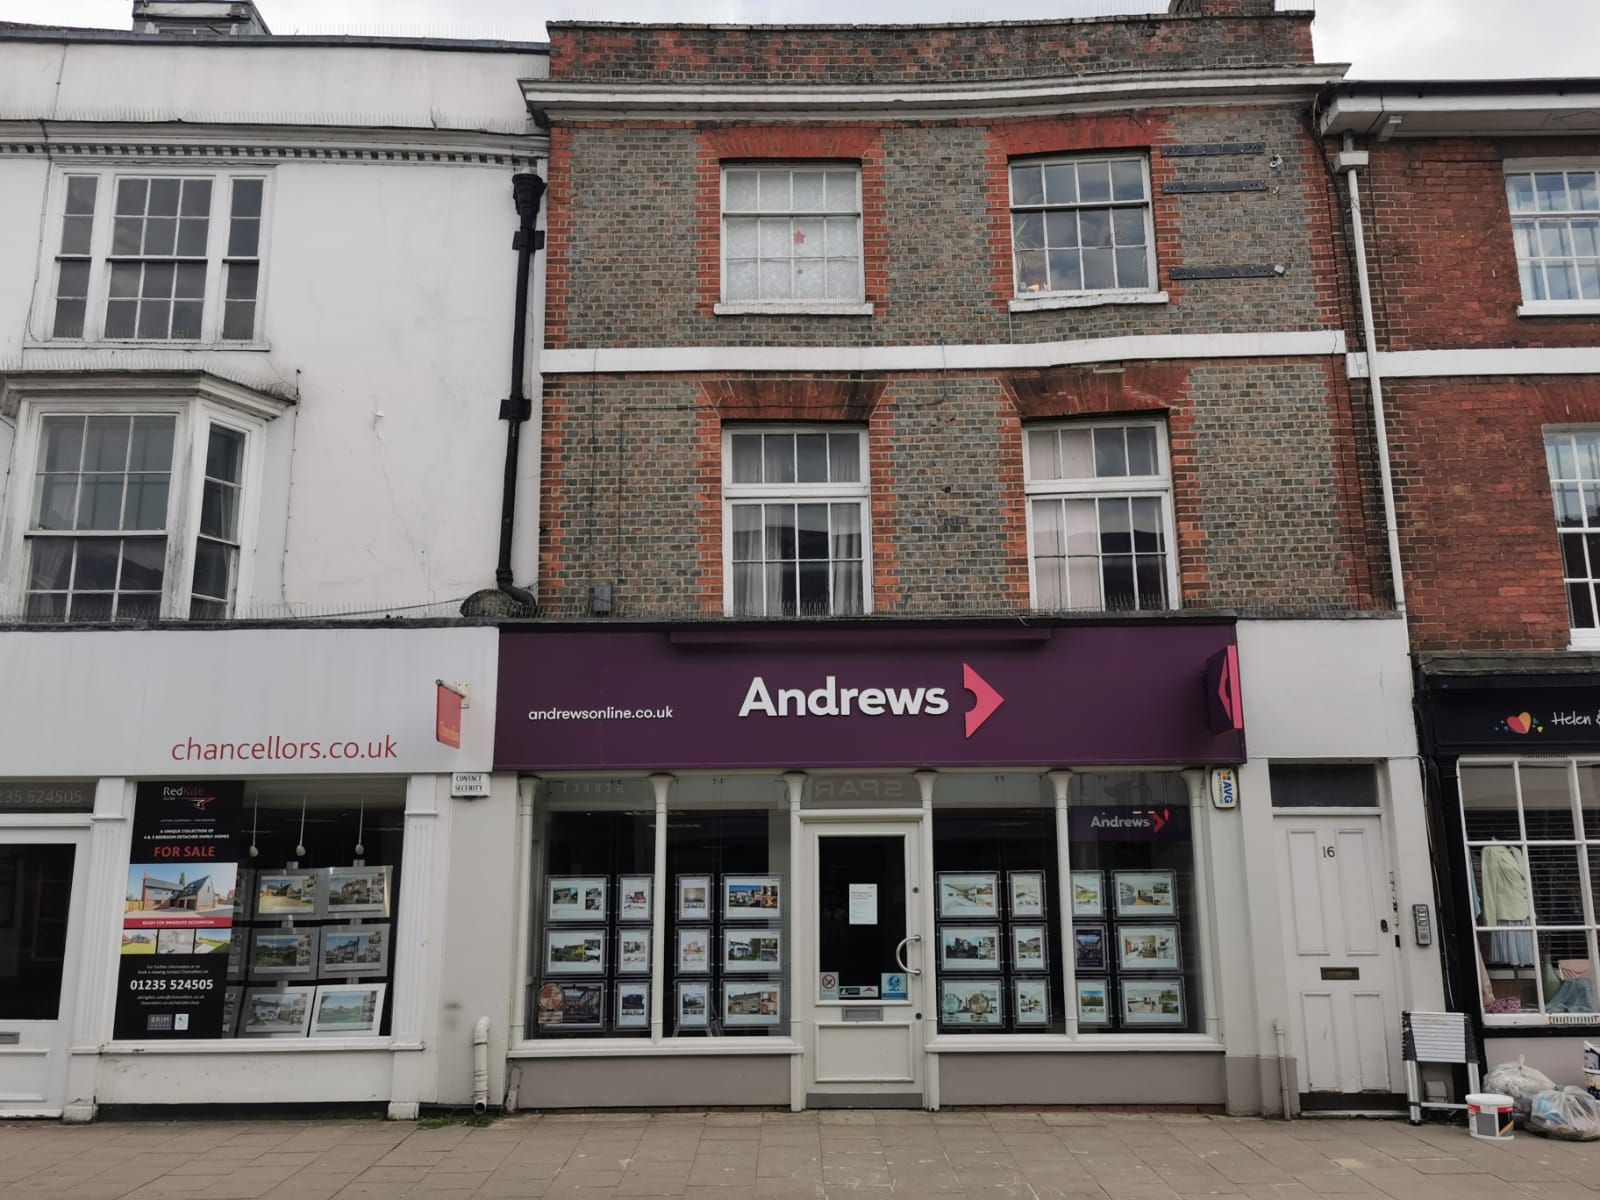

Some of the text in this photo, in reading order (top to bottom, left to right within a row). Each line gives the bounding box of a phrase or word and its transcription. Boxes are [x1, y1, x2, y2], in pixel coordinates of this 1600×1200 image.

[738, 676, 949, 717] Andrews
[528, 706, 673, 720] andrewsonline.co.uk
[1551, 710, 1592, 726] Helen
[171, 734, 398, 761] chancellors.co.uk
[27, 790, 81, 803] 524505
[1223, 781, 1233, 804] AVG
[1091, 815, 1150, 828] Andrews
[154, 846, 215, 857] FOR SALE
[1322, 846, 1336, 858] 16
[130, 979, 214, 991] 01235 524505
